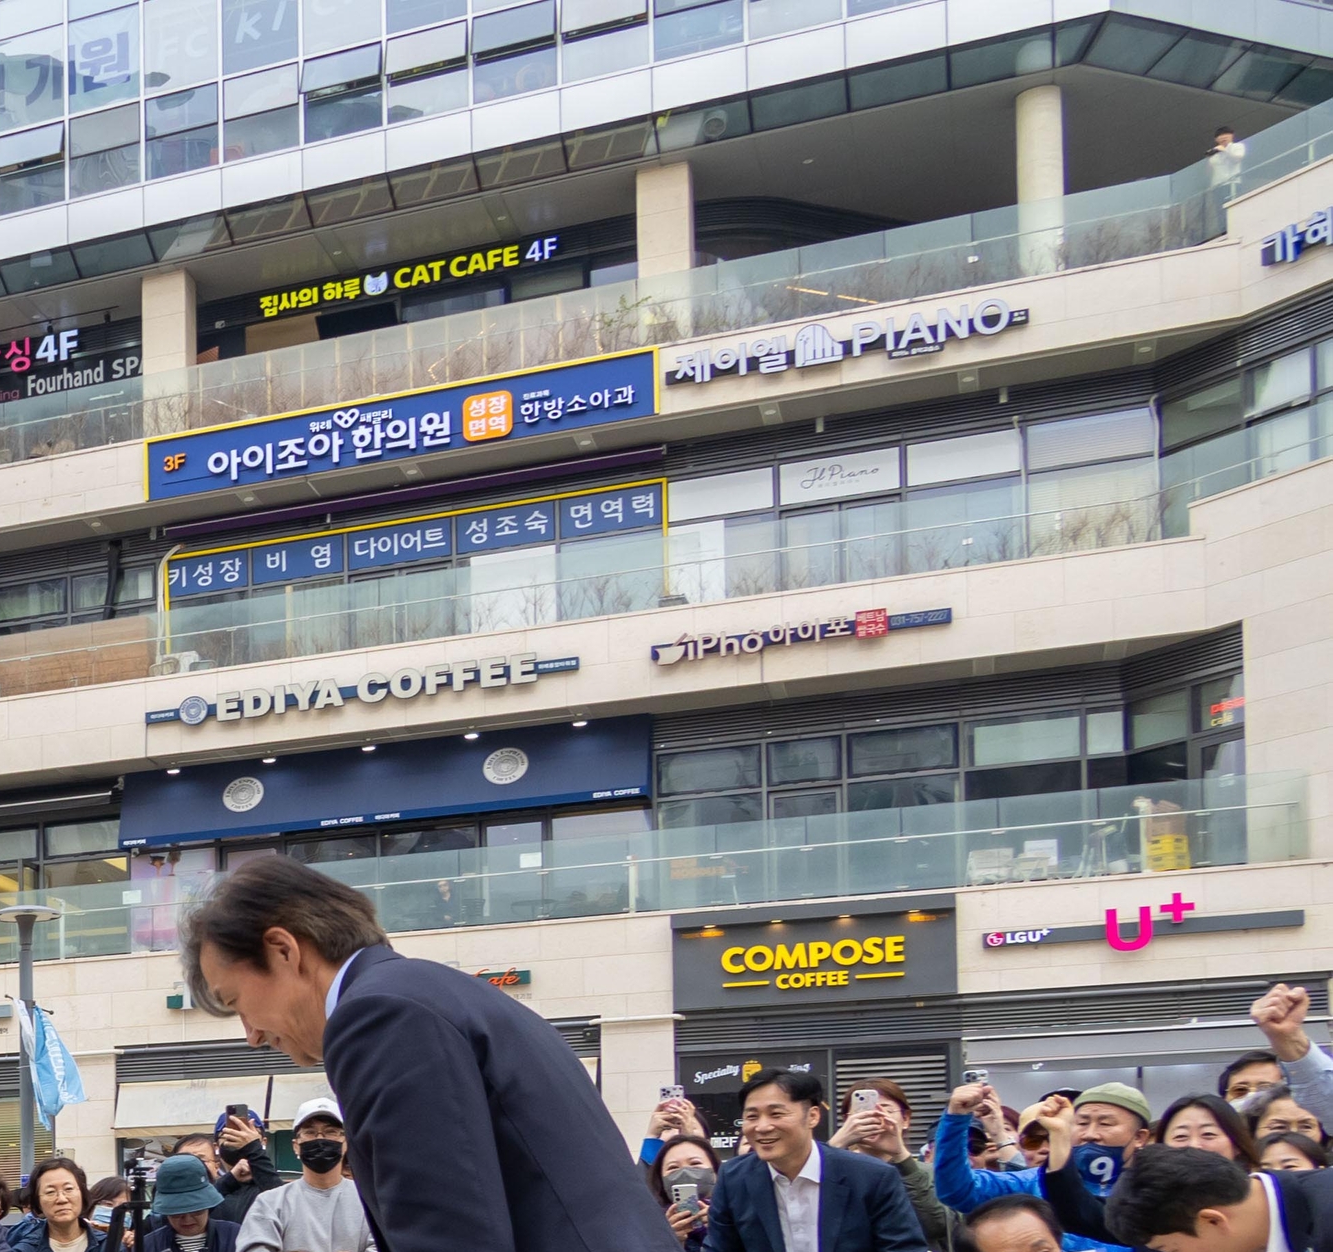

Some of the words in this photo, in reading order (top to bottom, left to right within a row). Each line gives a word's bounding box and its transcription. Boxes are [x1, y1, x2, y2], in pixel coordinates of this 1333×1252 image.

[259, 286, 318, 318] 집사의
[323, 277, 361, 301] 하루
[393, 260, 445, 289] CAT
[449, 245, 520, 277] CAFE
[525, 236, 558, 262] 4F
[35, 328, 79, 363] 4F
[675, 334, 789, 384] 제이엘
[851, 298, 1010, 358] PIANO
[26, 359, 104, 397] Fourhand
[468, 395, 508, 418] 성장
[519, 384, 635, 426] 한방소아과
[467, 415, 508, 438] 면역
[163, 452, 186, 473] 3F
[206, 428, 344, 482] 아이조아
[350, 410, 451, 456] 한의원
[353, 526, 446, 561] 다이어트
[465, 508, 549, 545] 성조숙
[569, 492, 656, 531] 면역력
[768, 614, 852, 647] 아이포
[856, 610, 886, 624] 베트남
[890, 609, 949, 626] 031-757-2227
[216, 678, 345, 722] EDIYA
[355, 651, 539, 703] COFFEE
[613, 787, 641, 797] COFFEE
[339, 815, 364, 825] COFFEE
[1104, 891, 1194, 952] U+
[720, 935, 906, 975] COMPOSE
[776, 969, 849, 989] COFFEE
[693, 1064, 740, 1084] Specialty
[1088, 1156, 1116, 1183] 9
